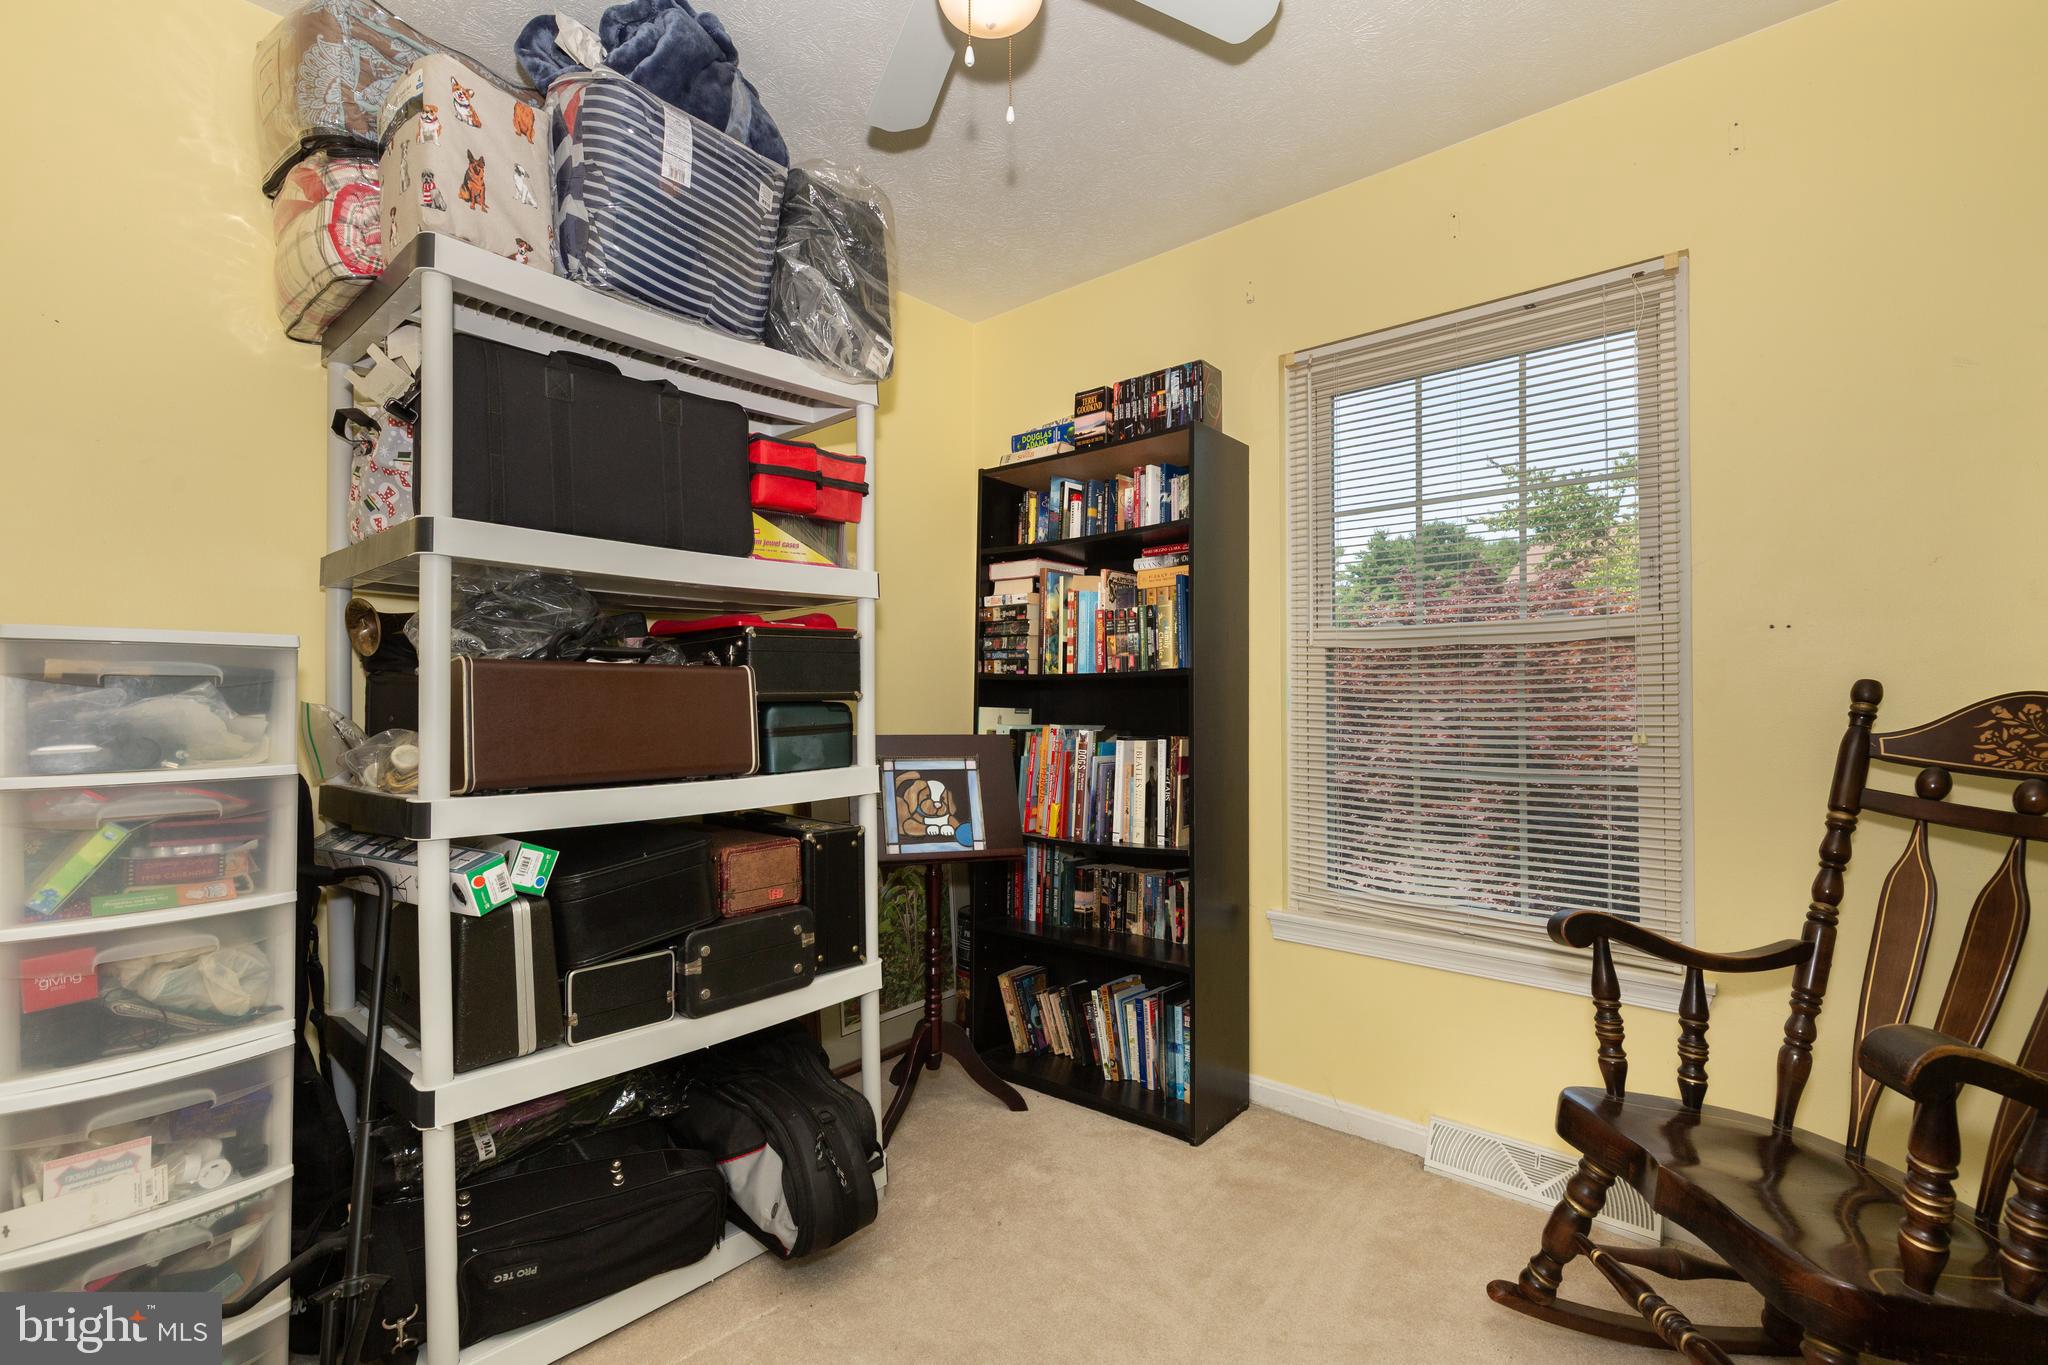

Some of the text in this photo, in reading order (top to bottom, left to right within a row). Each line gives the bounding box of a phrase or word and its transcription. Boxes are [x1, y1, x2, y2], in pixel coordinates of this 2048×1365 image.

[1082, 396, 1098, 406] TERRY
[1076, 402, 1103, 415] GOODKIND
[1021, 430, 1053, 444] DOUGLAS
[1025, 439, 1049, 450] ADAMS
[763, 539, 781, 548] jewel
[1078, 749, 1087, 770] DOGS
[1135, 751, 1143, 788] BEATLES
[38, 973, 82, 991] giving
[493, 1265, 538, 1283] PRO TEC
